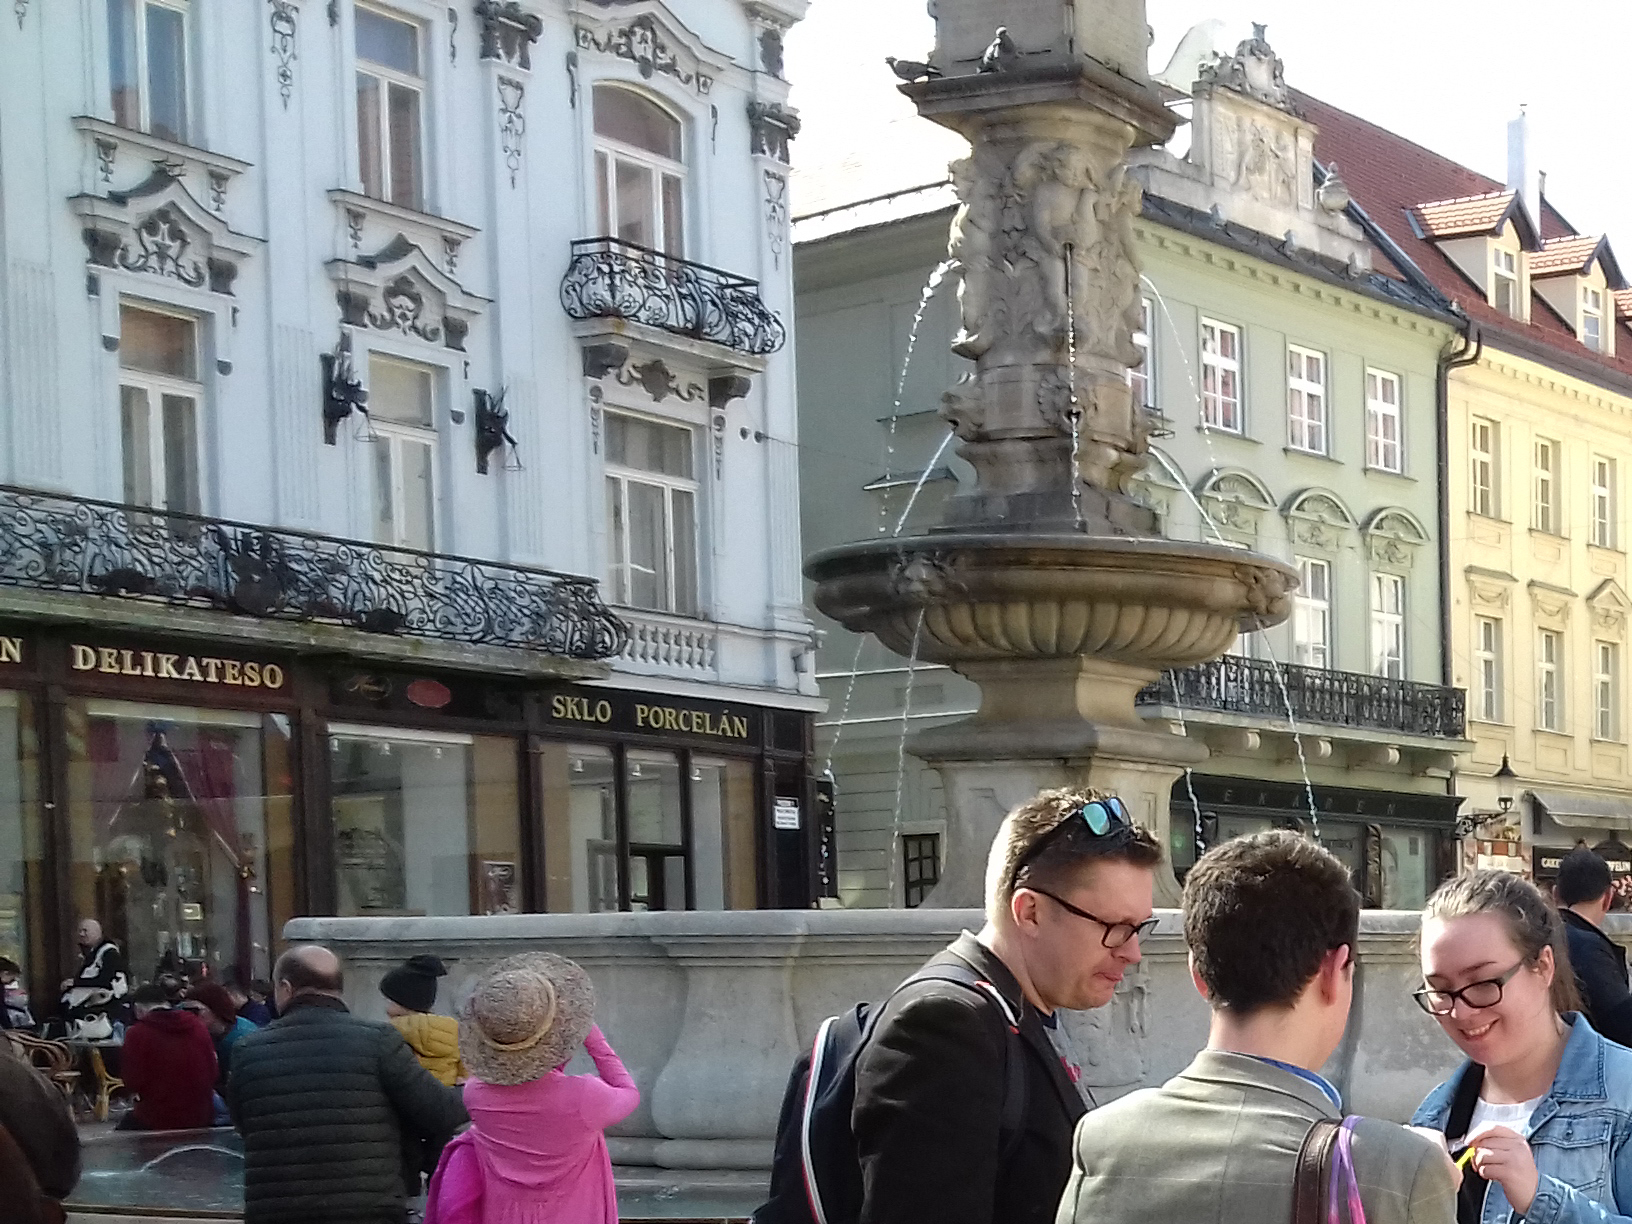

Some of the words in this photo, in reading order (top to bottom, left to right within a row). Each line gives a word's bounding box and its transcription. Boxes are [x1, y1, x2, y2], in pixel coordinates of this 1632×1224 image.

[71, 644, 284, 689] DELIKATESO
[552, 695, 612, 723] SKLO
[635, 704, 748, 738] PORCELÁN
